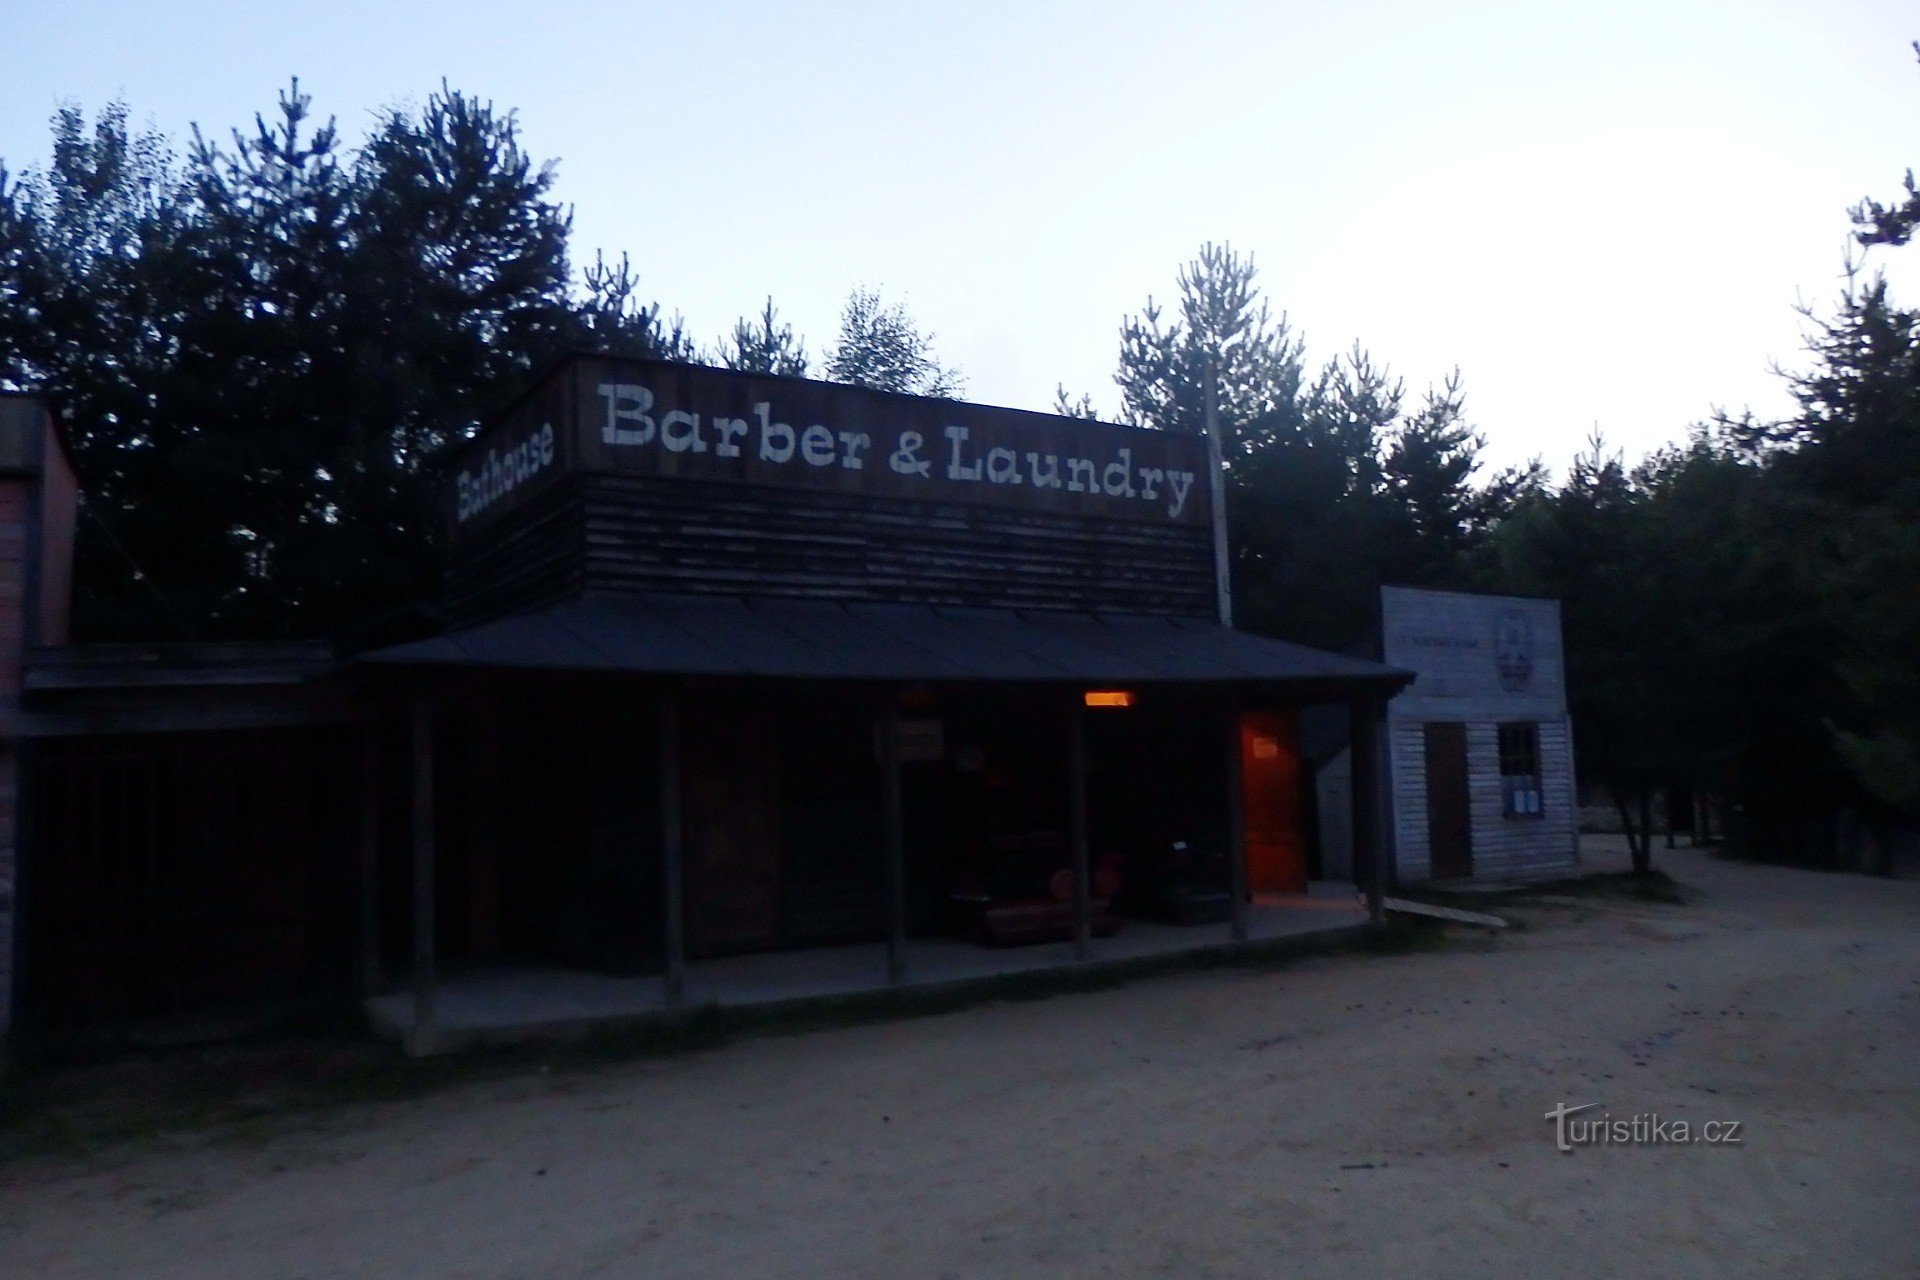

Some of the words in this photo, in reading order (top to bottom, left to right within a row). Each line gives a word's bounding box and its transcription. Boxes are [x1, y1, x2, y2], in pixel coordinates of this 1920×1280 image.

[597, 383, 871, 471] Barber
[889, 430, 932, 478] &
[945, 425, 1196, 518] Laundry
